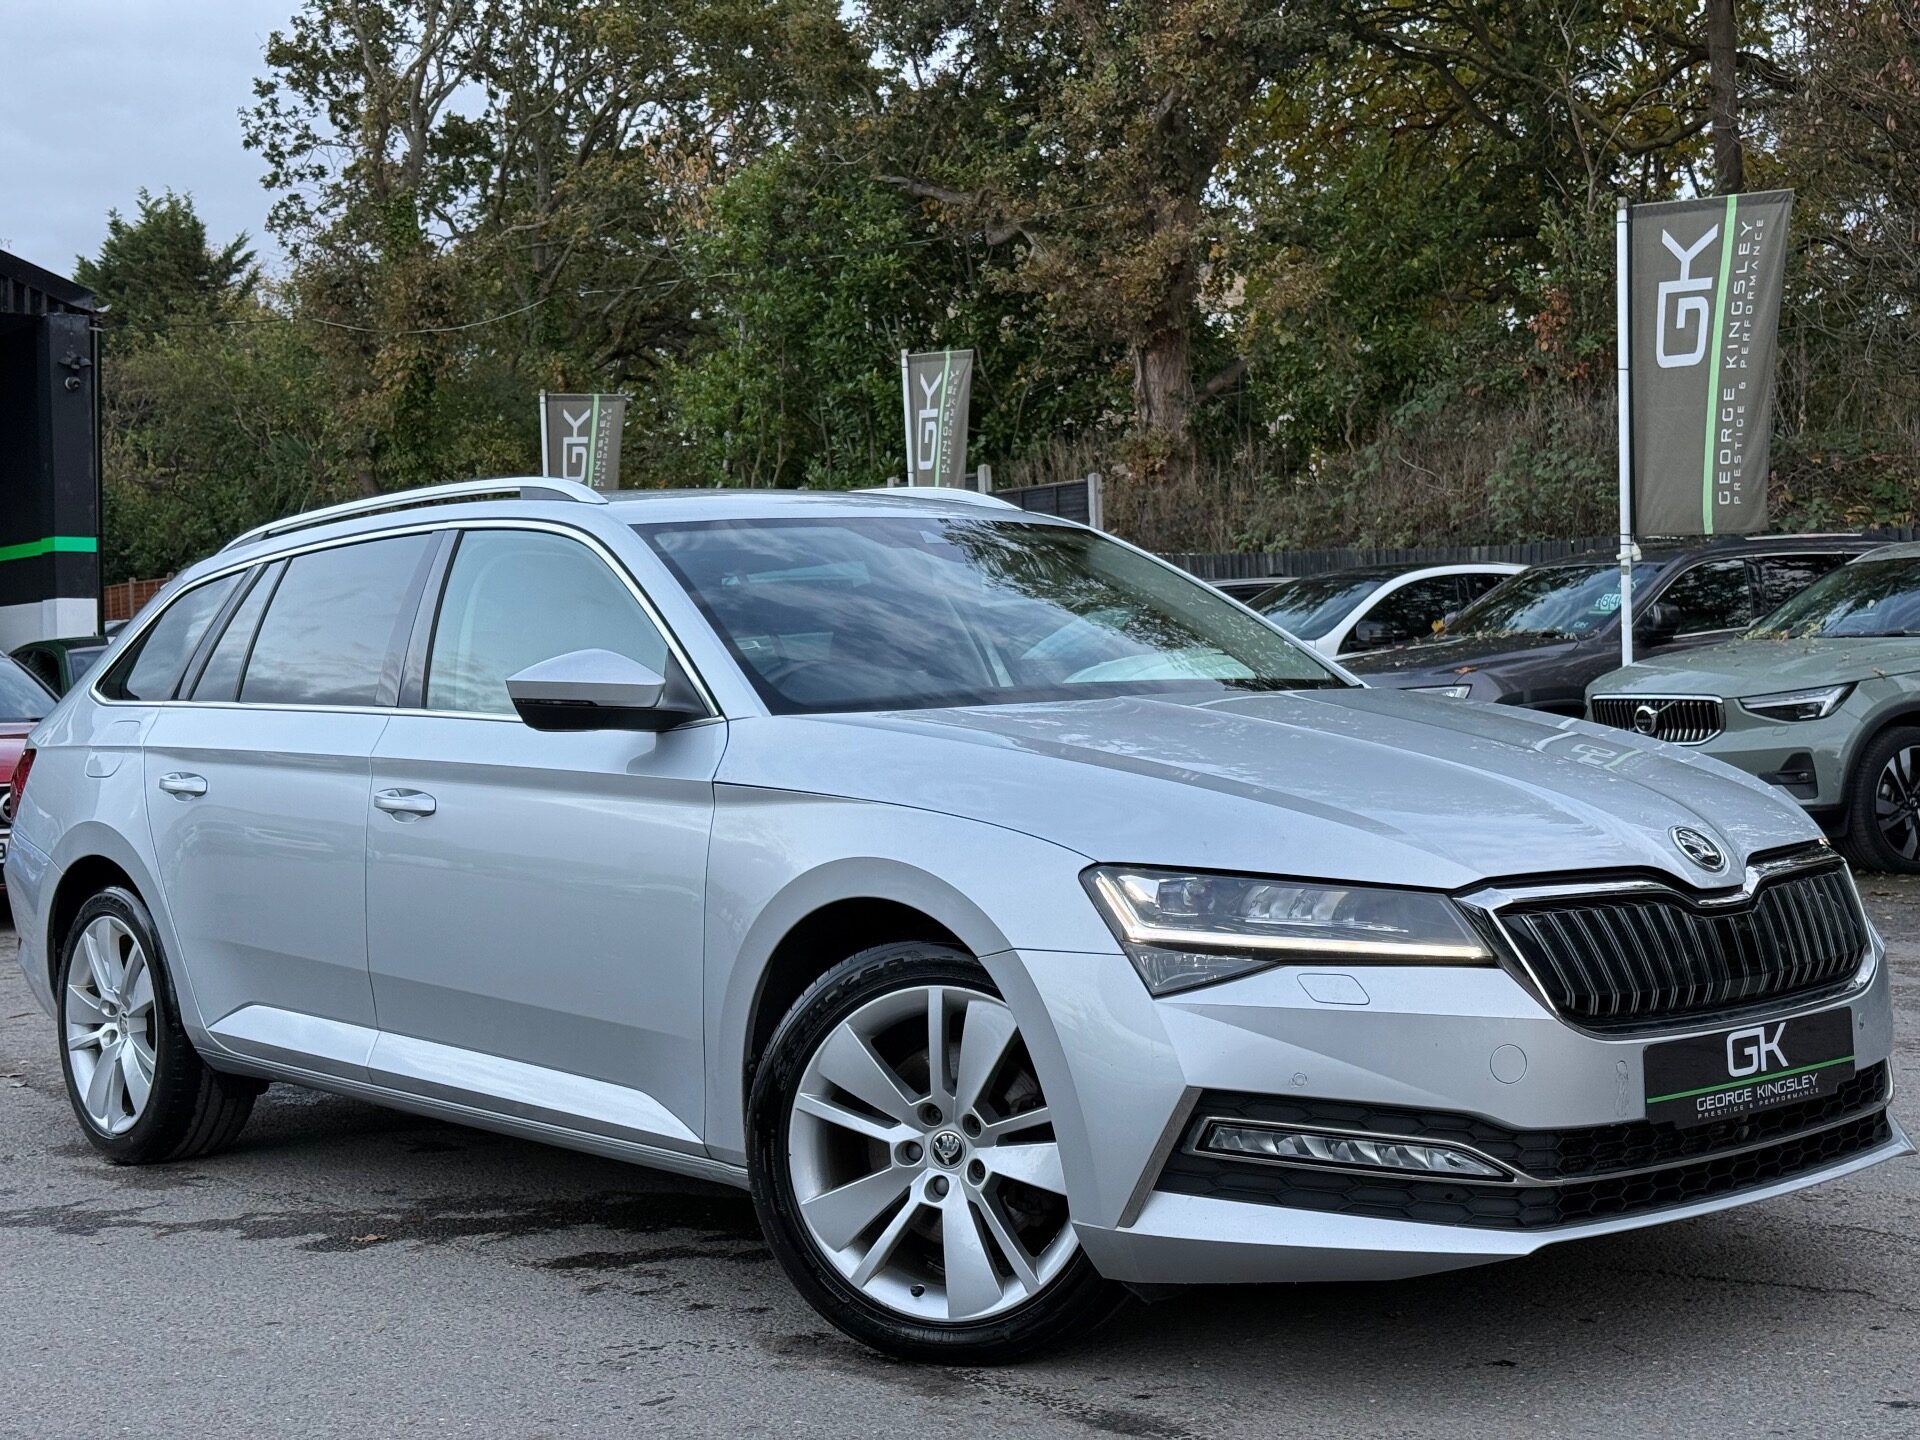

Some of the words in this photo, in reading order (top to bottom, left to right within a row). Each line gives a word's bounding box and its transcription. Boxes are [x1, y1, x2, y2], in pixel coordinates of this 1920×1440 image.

[1656, 223, 1719, 369] GK
[1725, 220, 1753, 369] KINGSLEY
[1733, 405, 1746, 505] PRESTIGE
[1740, 218, 1764, 369] PERFORMANCE
[562, 408, 591, 482] GK
[594, 408, 608, 487] KINGSLEY
[918, 371, 943, 470] GK
[1718, 387, 1735, 505] GEORGE
[1696, 1088, 1753, 1111] GEORGE
[1756, 1072, 1818, 1098] KINGSLEY
[1726, 1021, 1789, 1078] GK
[1698, 1104, 1744, 1120] PRESTIGE
[1759, 1087, 1819, 1106] PERFORMANCE
